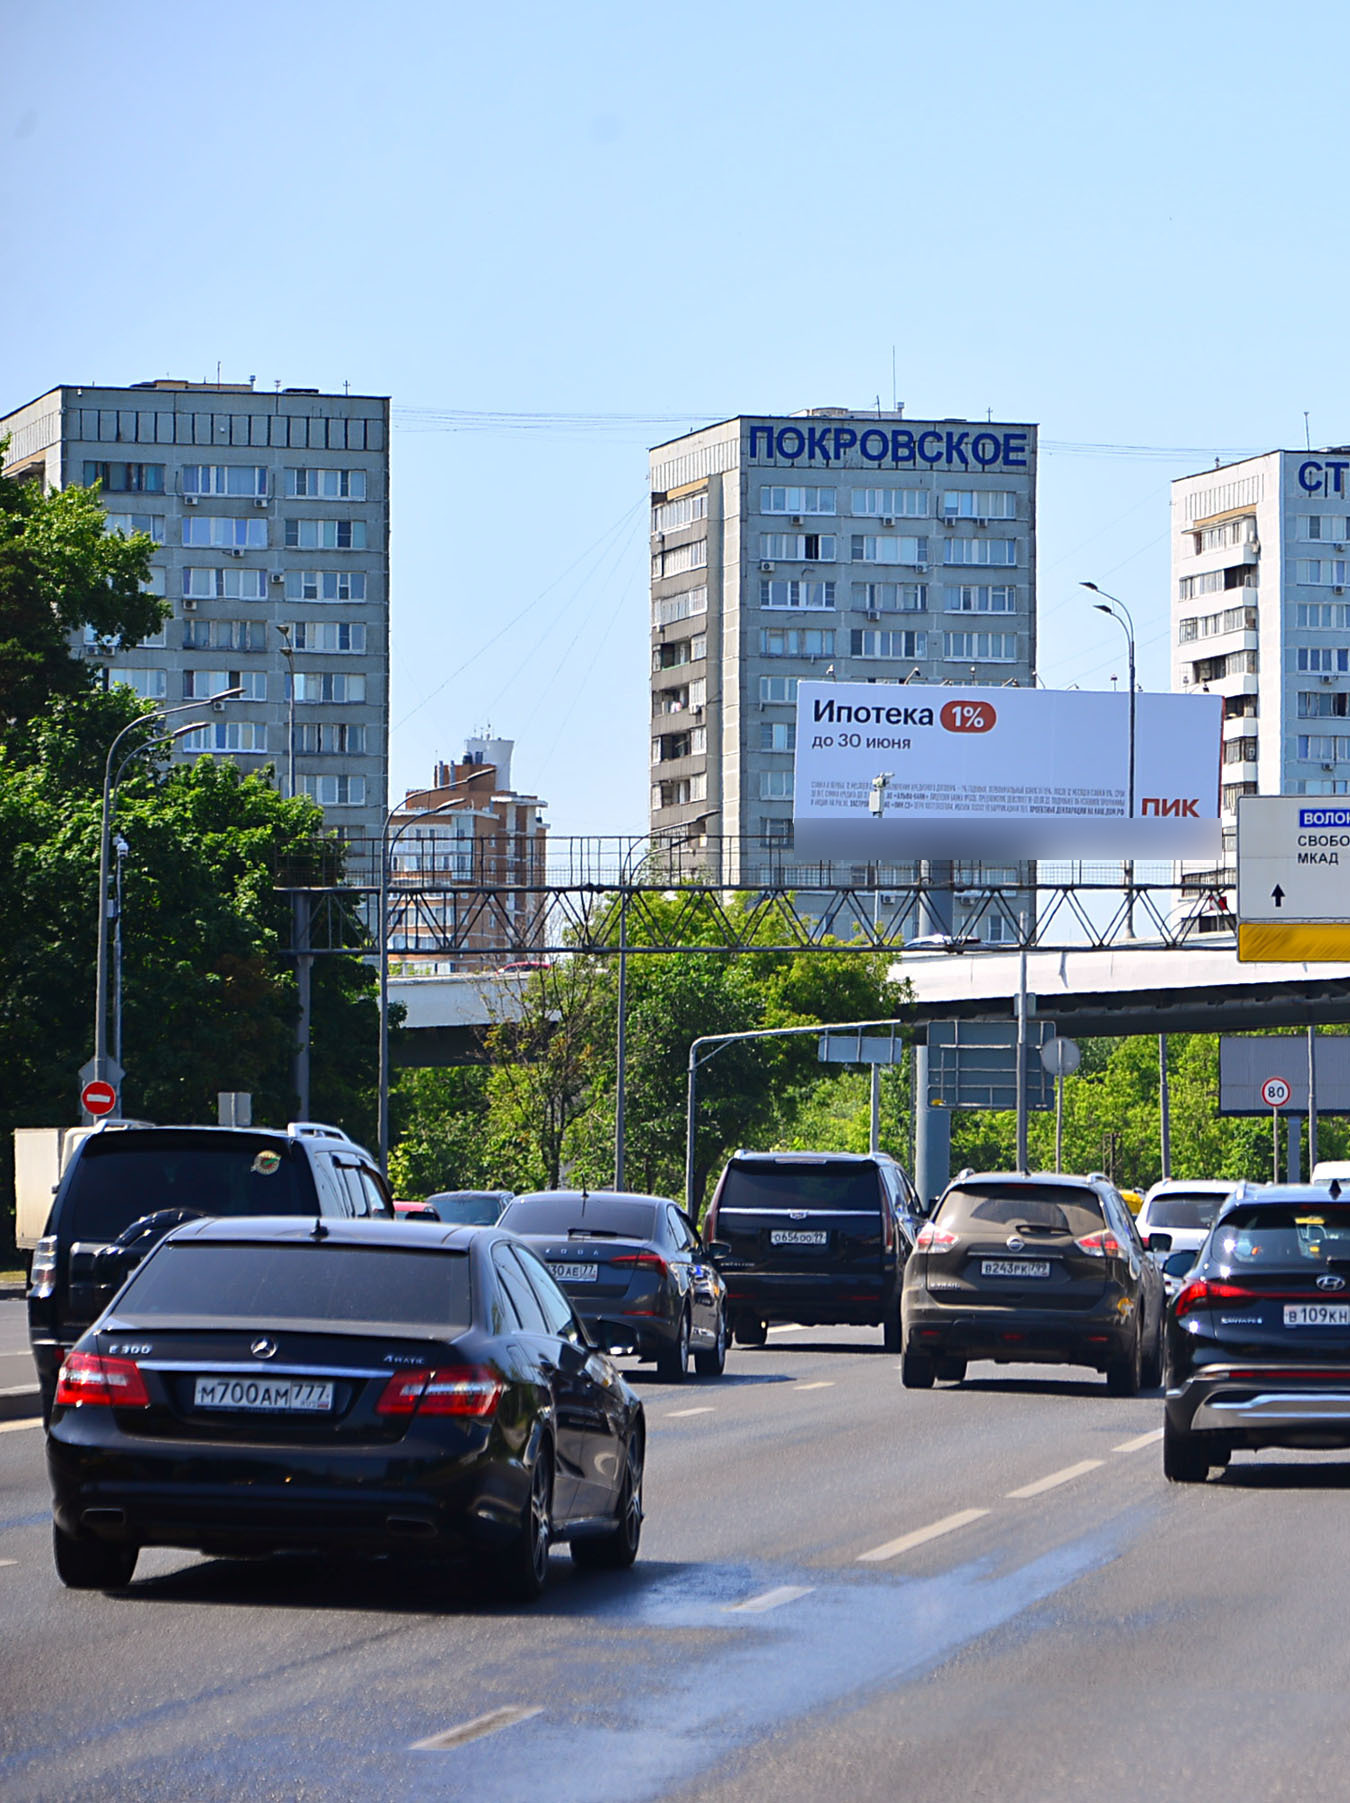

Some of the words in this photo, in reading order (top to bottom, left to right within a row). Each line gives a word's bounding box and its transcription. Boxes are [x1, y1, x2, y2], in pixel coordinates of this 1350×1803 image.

[749, 425, 1028, 467] ПОКРОВСКОЕ
[813, 699, 934, 726] Ипотека
[951, 705, 985, 728] 1%
[812, 734, 834, 750] до
[838, 733, 862, 748] 30
[866, 736, 911, 750] июня
[1142, 798, 1200, 818] ПИК
[1297, 852, 1339, 866] МКАД
[1268, 1086, 1285, 1098] 80
[581, 1264, 595, 1274] 77
[1288, 1307, 1348, 1323] В109КН
[199, 1381, 289, 1406] М700АМ
[292, 1383, 328, 1401] 777
